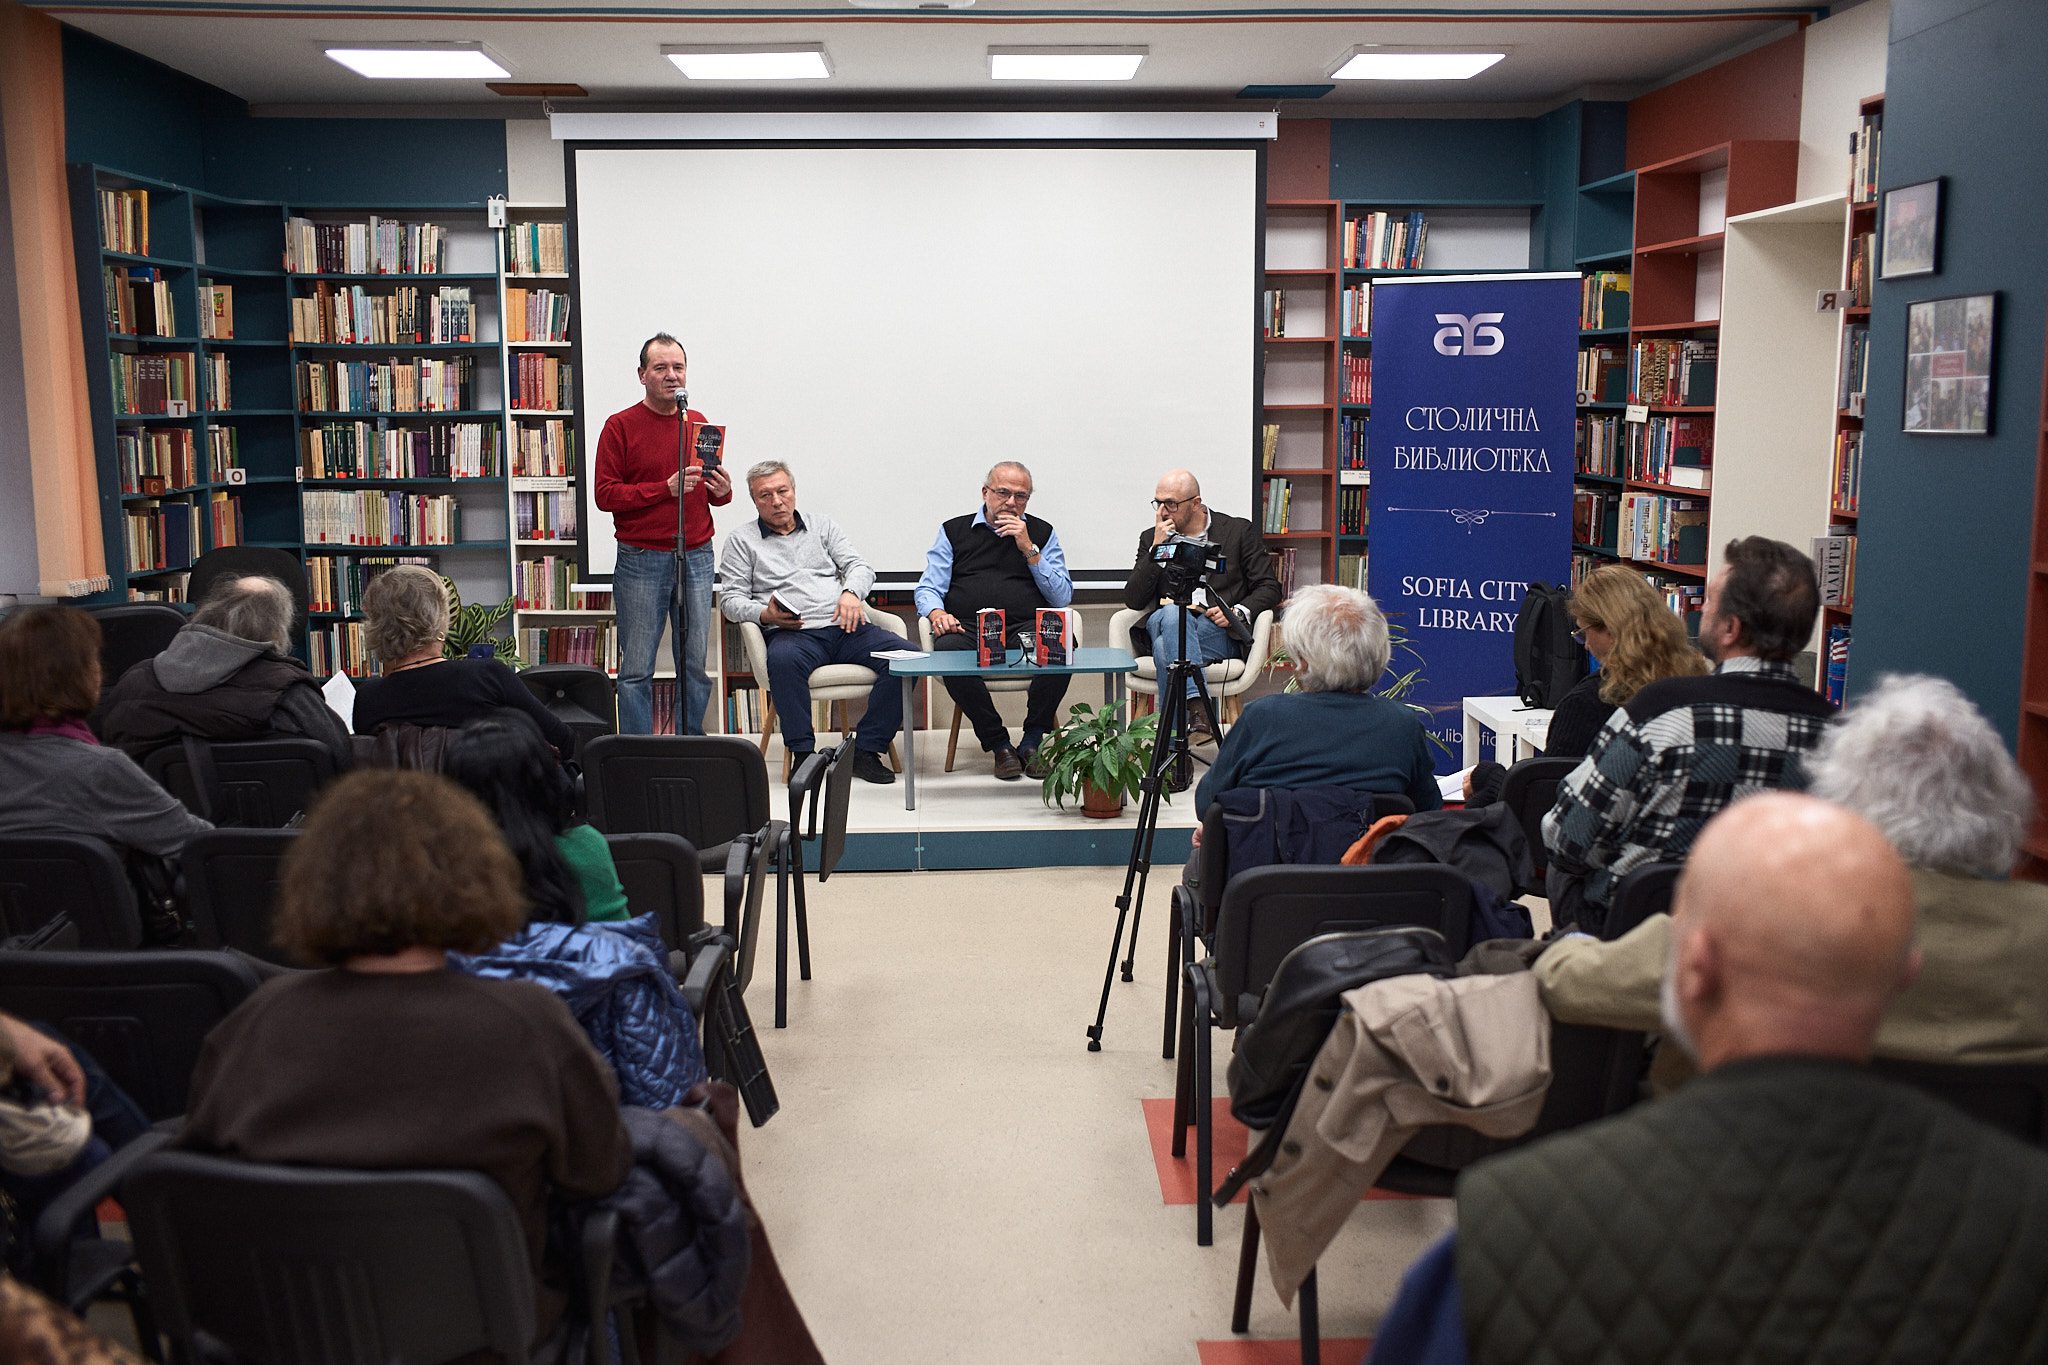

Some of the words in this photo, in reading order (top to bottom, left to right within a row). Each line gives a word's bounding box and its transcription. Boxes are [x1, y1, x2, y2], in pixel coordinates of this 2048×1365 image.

[1821, 292, 1837, 310] Я
[1405, 406, 1540, 432] СТОЛИЧНА
[1393, 446, 1552, 473] БИБЛИОТЕКА
[1402, 575, 1474, 600] SOFIA
[1479, 579, 1529, 602] CIT
[1418, 607, 1520, 633] LIBRARY
